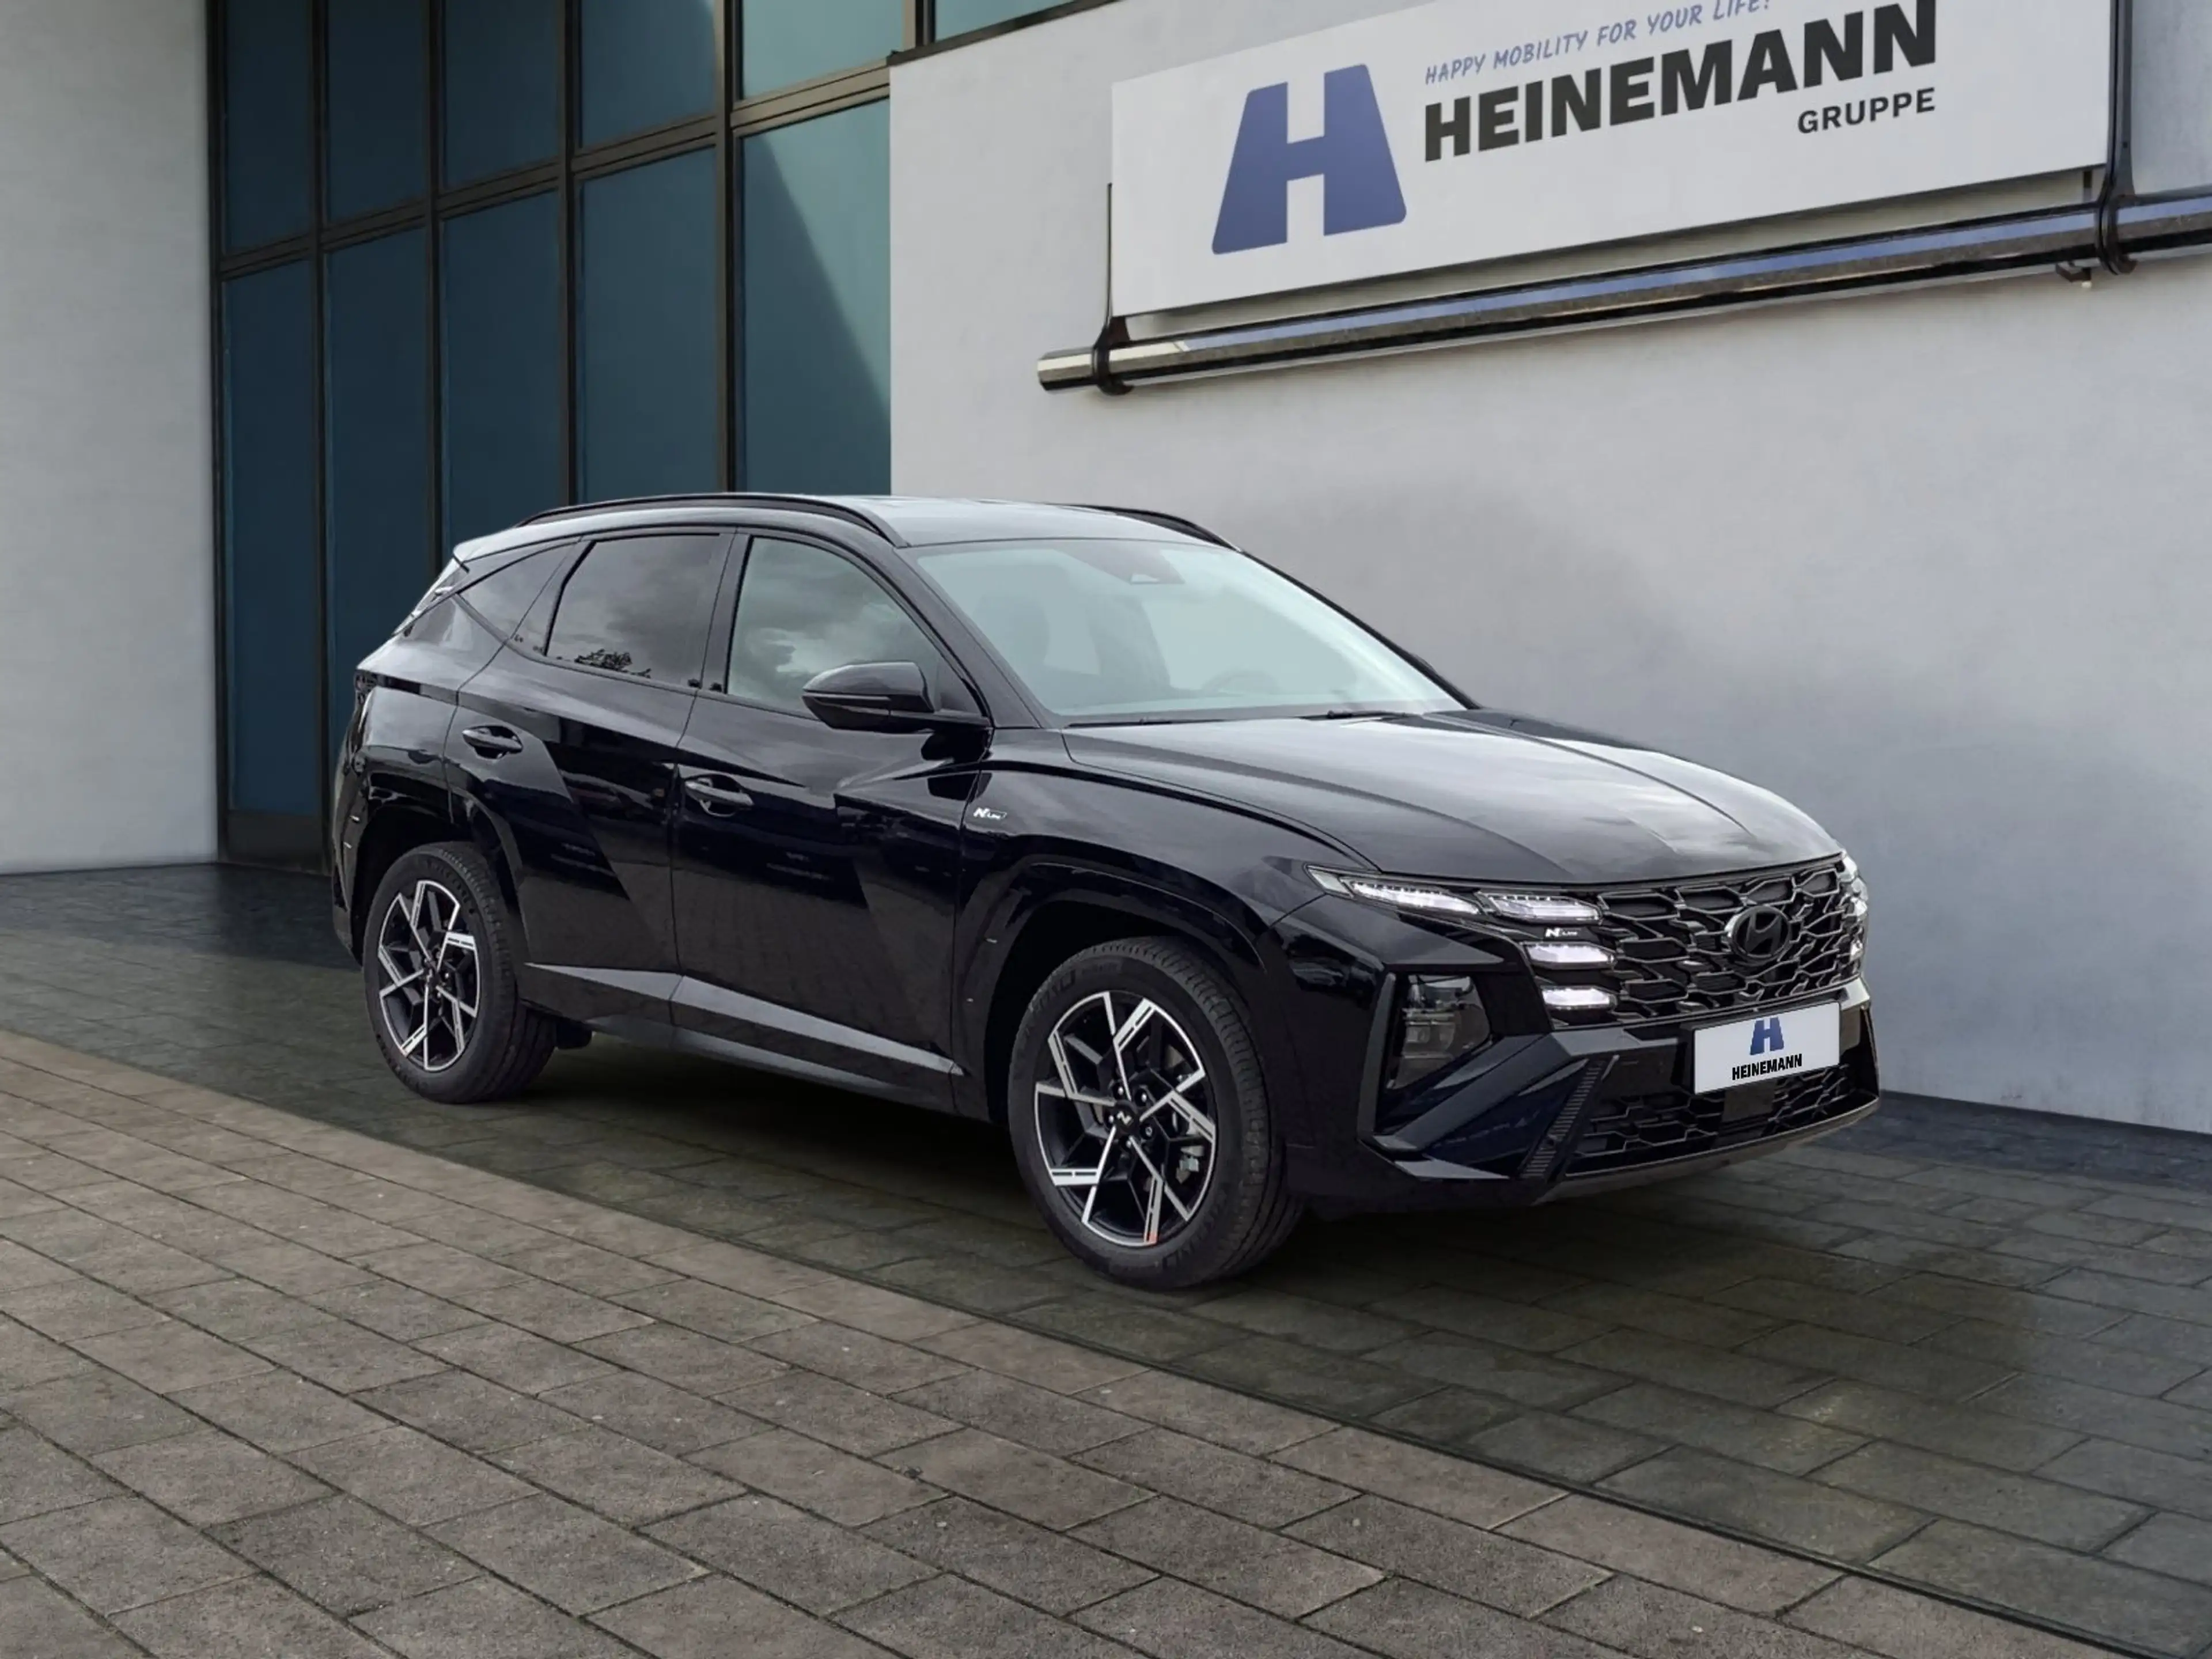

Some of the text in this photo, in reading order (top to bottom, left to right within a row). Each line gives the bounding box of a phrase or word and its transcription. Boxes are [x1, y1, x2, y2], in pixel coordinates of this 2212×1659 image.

[1425, 54, 1486, 85] HAPPY
[1493, 30, 1589, 70] MOBILITY
[1596, 18, 1637, 47] FOR
[1647, 5, 1703, 36] YOUR
[1425, 0, 1936, 162] HEINEMANN
[1798, 87, 1936, 134] GRUPPE
[1732, 1053, 1802, 1081] HEINEMANN
